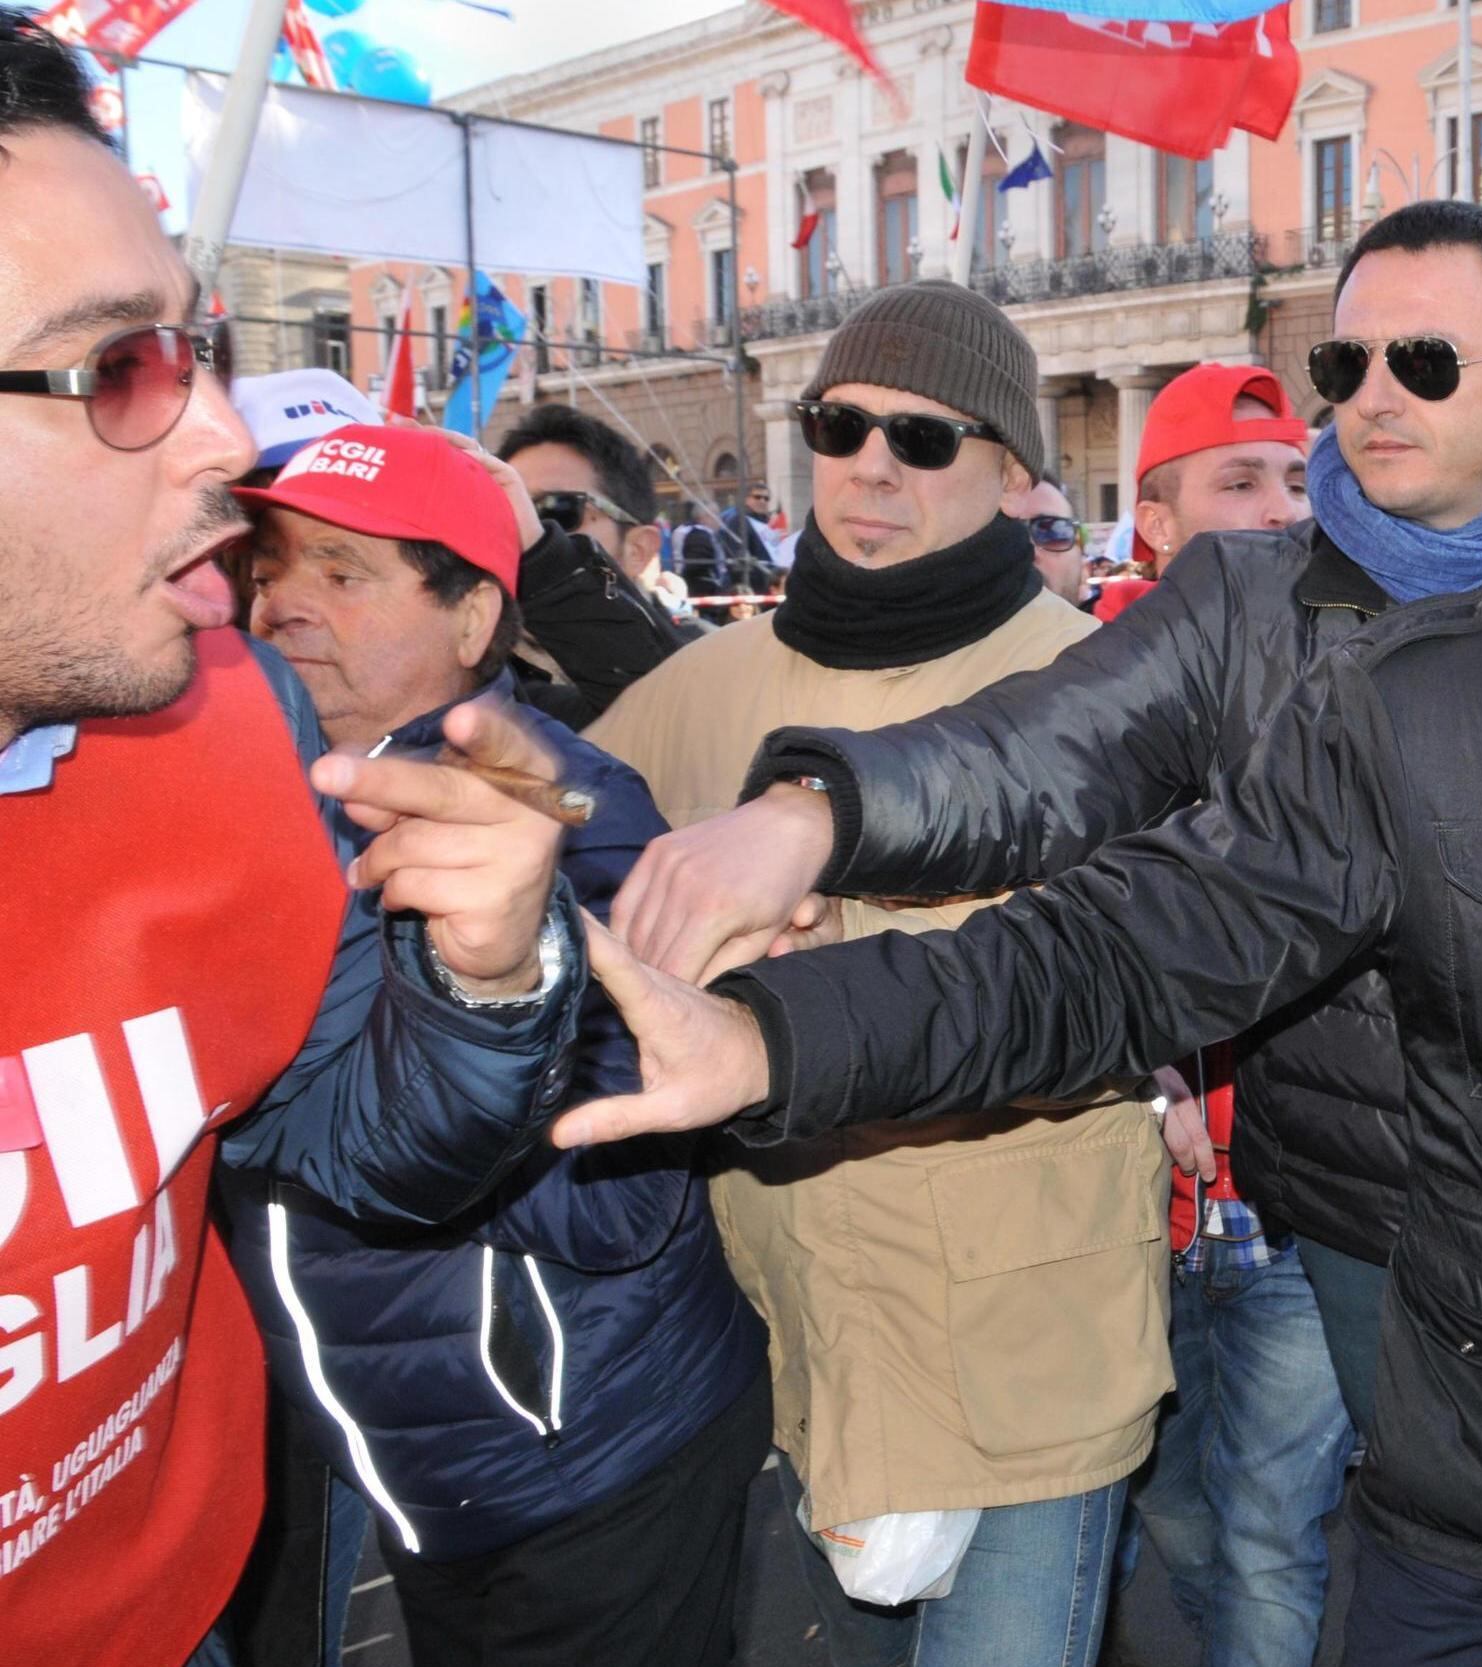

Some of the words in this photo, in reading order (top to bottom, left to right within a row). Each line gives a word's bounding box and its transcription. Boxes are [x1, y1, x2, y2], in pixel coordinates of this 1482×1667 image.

[307, 456, 380, 482] BARI
[321, 438, 386, 466] CGIL
[53, 1336, 181, 1492] UGUAGLIANZA
[0, 1502, 60, 1578] IARE
[65, 1426, 145, 1522] L'ITALIA
